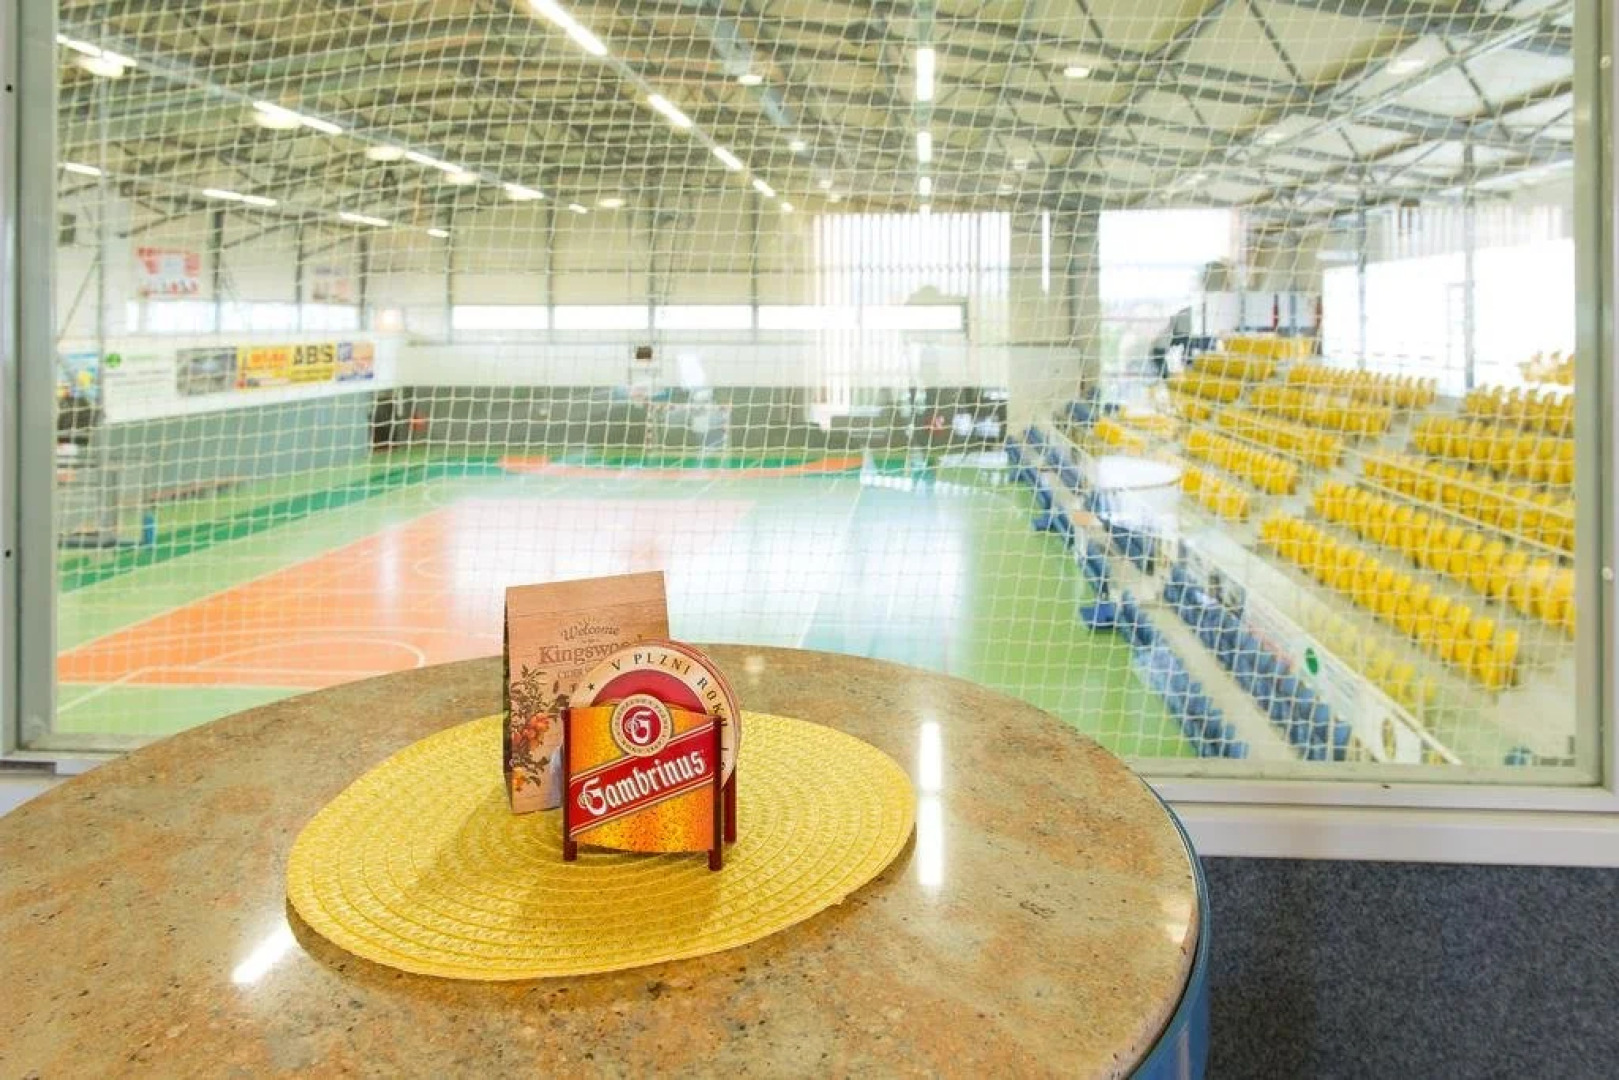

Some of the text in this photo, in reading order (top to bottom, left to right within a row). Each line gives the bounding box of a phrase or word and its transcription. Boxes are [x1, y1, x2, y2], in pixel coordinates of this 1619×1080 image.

[293, 345, 333, 365] ABS
[561, 621, 620, 640] Welcome
[539, 633, 643, 665] Kingswo
[611, 659, 620, 670] V
[634, 653, 691, 675] PLZNI
[577, 751, 705, 815] Gambrinus
